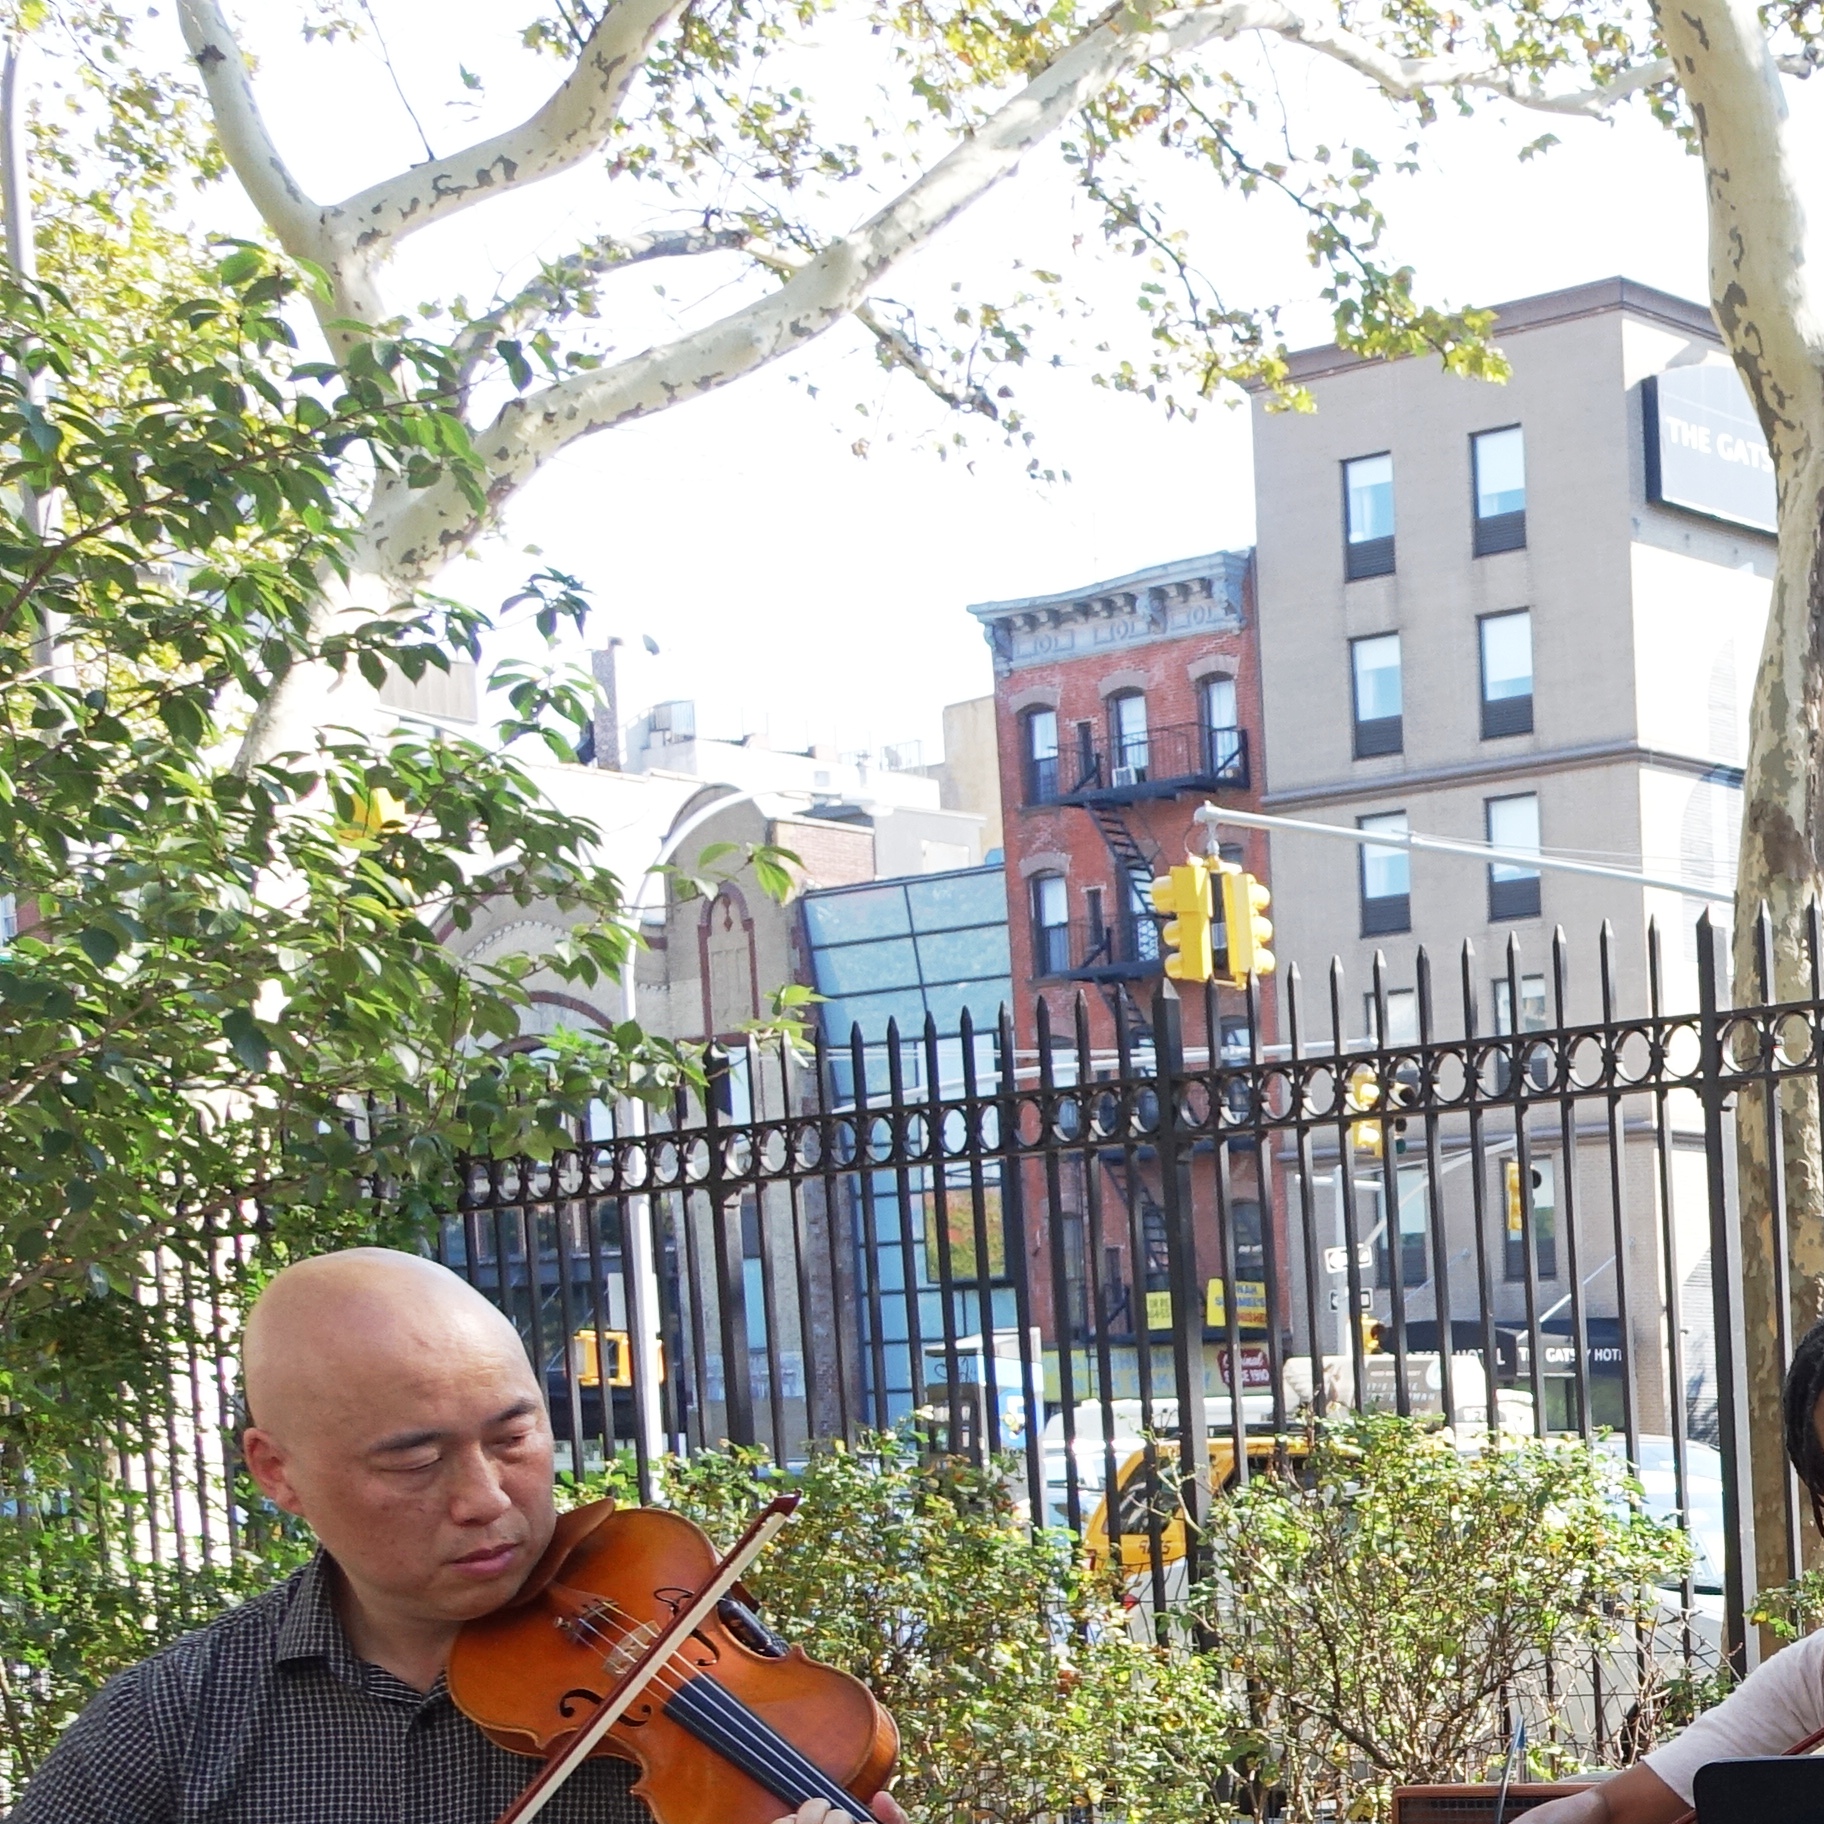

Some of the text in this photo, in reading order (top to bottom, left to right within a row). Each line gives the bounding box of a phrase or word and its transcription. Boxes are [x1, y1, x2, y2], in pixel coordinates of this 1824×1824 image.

[1664, 415, 1775, 474] THE GATS
[1594, 1348, 1622, 1362] HOT
